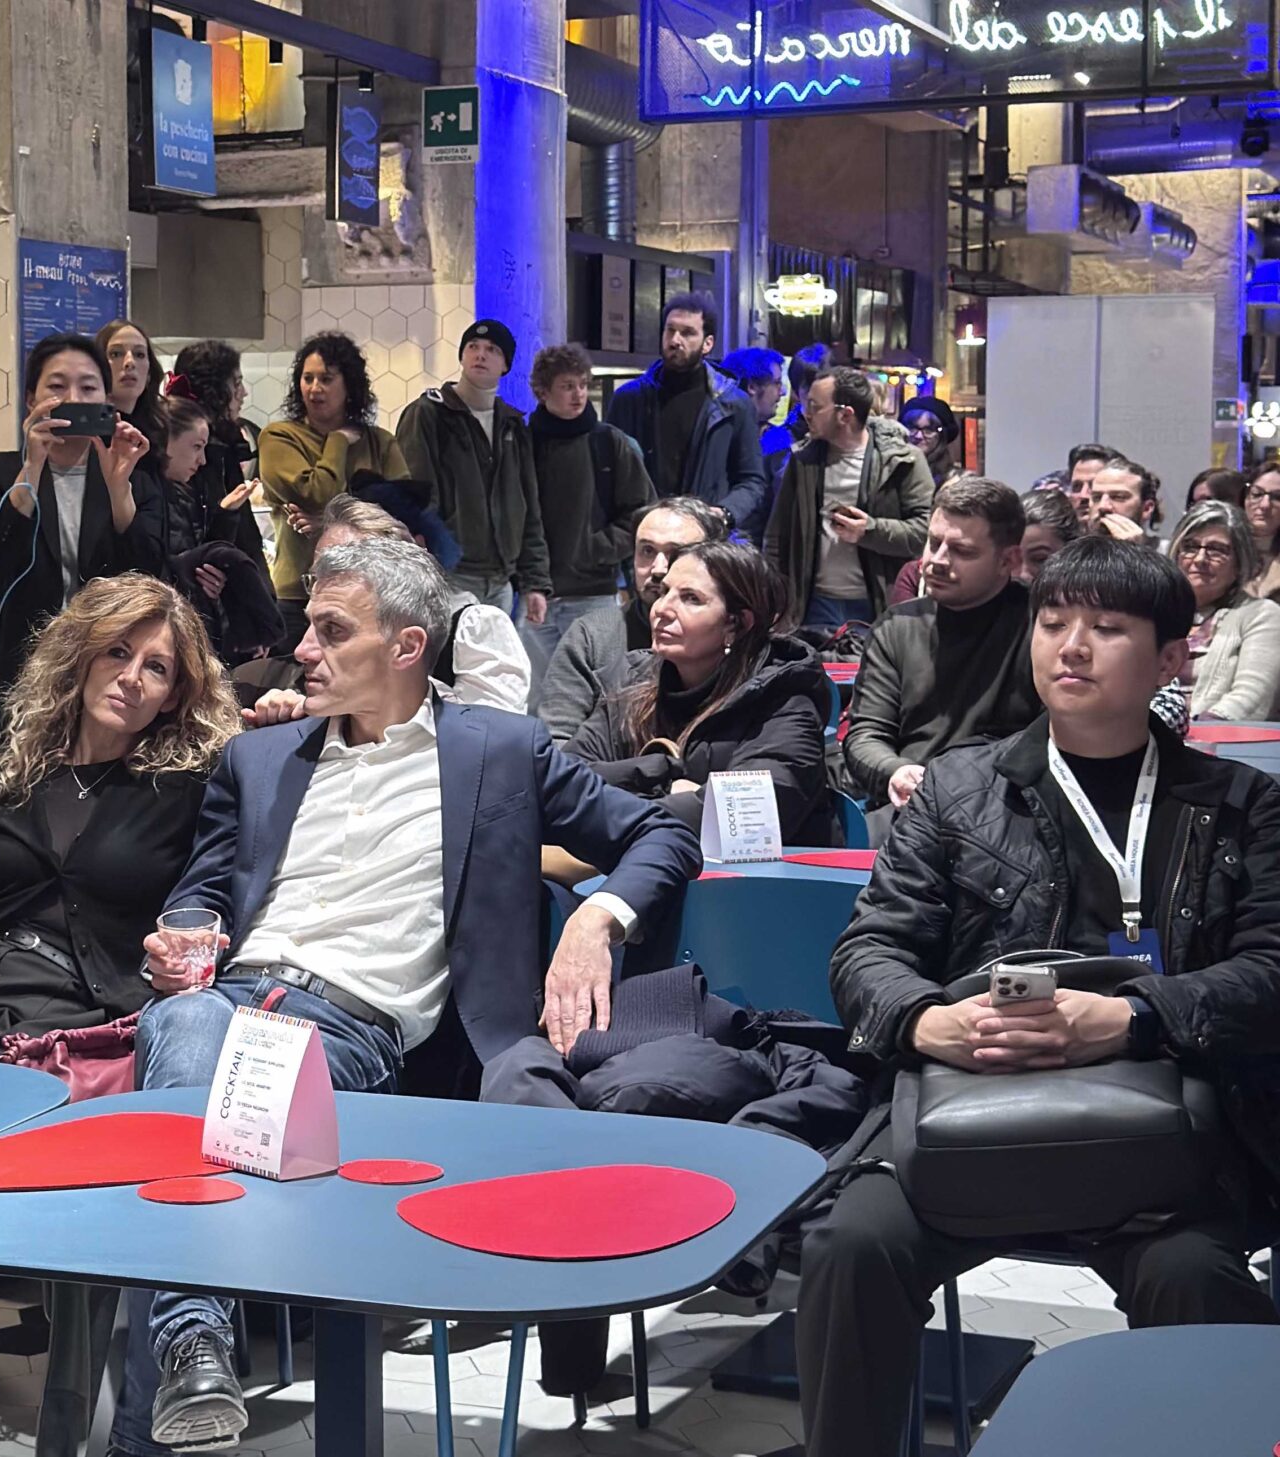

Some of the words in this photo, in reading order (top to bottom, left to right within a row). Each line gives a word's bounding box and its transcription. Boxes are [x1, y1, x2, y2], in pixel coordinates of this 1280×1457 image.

[160, 112, 168, 133] la
[170, 120, 209, 142] pescheria
[163, 144, 178, 159] con
[180, 145, 208, 165] cucina
[726, 796, 737, 837] COCKTAIL
[1076, 797, 1089, 816] KOREA
[220, 1050, 245, 1119] COCKTAIL
